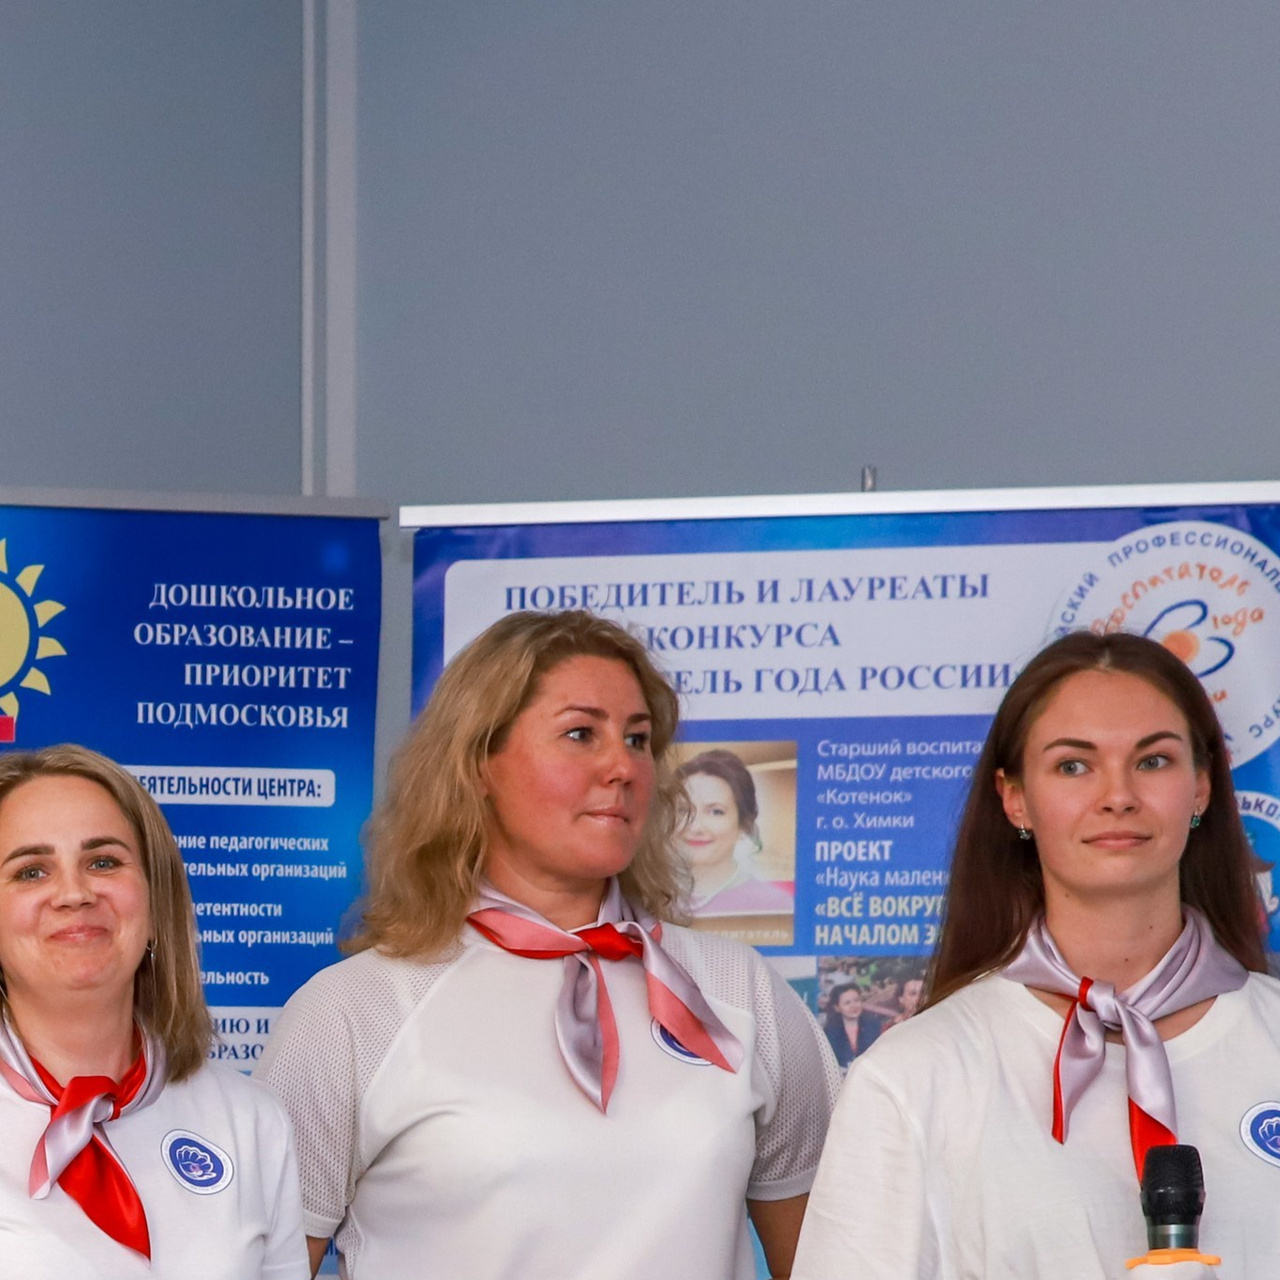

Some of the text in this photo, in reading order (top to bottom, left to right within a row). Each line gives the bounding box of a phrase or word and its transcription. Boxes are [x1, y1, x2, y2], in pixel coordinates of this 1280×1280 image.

[148, 583, 354, 611] ДОШКОЛЬНОЕ
[505, 573, 990, 611] ПОБЕДИТЕЛЬ И ЛАУРЕАТЫ
[133, 622, 331, 650] ОБРАЗОВАНИЕ
[646, 622, 842, 650] КОНКУРСА
[184, 663, 352, 689] ПРИОРИТЕТ
[754, 667, 847, 697] ГОДА
[136, 701, 349, 729] ПОДМОСКОВЬЯ
[817, 739, 901, 759] Старший
[817, 763, 887, 783] МБДОУ
[135, 775, 322, 799] ЕЯТЕЛЬНОСТИ ЦЕНТРА:
[816, 788, 913, 805] «Котенок»
[816, 812, 915, 829] г. о. Химки
[210, 836, 329, 853] педагогических
[815, 840, 893, 862] ПРОЕКТ
[252, 861, 347, 881] организаций
[816, 867, 949, 891] «Наука мален
[815, 892, 863, 917] «ВСЁ
[238, 927, 334, 948] организаций
[815, 924, 919, 945] НАЧАЛОМ
